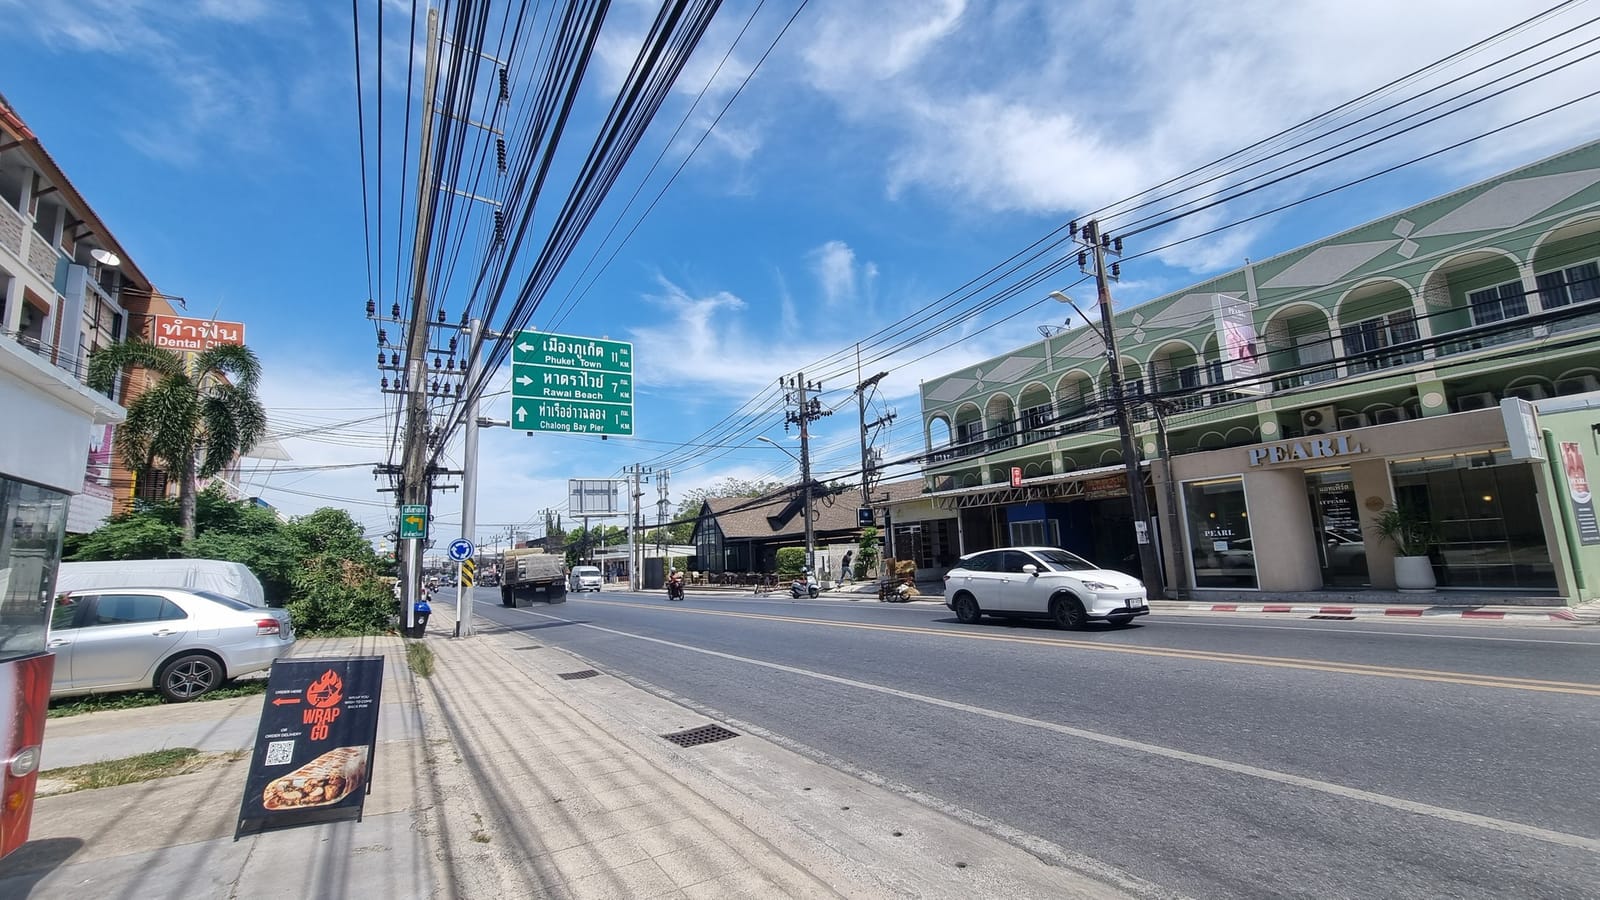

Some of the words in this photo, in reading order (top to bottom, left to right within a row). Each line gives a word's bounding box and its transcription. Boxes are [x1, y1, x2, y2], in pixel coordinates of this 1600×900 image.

[162, 319, 237, 340] ทำฟัน
[158, 336, 201, 349] Dental
[543, 338, 604, 359] เมืองภูเก็ต
[545, 355, 575, 366] Phuket
[580, 359, 602, 368] Town
[612, 352, 618, 363] 11
[543, 371, 605, 389] หาดราไวย์
[543, 388, 572, 398] Rawai
[574, 390, 604, 400] Beach
[612, 382, 619, 393] 7
[539, 402, 606, 421] ท่าเรืออ่าวฉลอง
[615, 414, 619, 425] 1
[540, 421, 571, 433] Chalong
[573, 422, 587, 433] Bay
[590, 423, 605, 431] Pier
[303, 708, 340, 724] WRAP
[311, 725, 329, 741] GO
